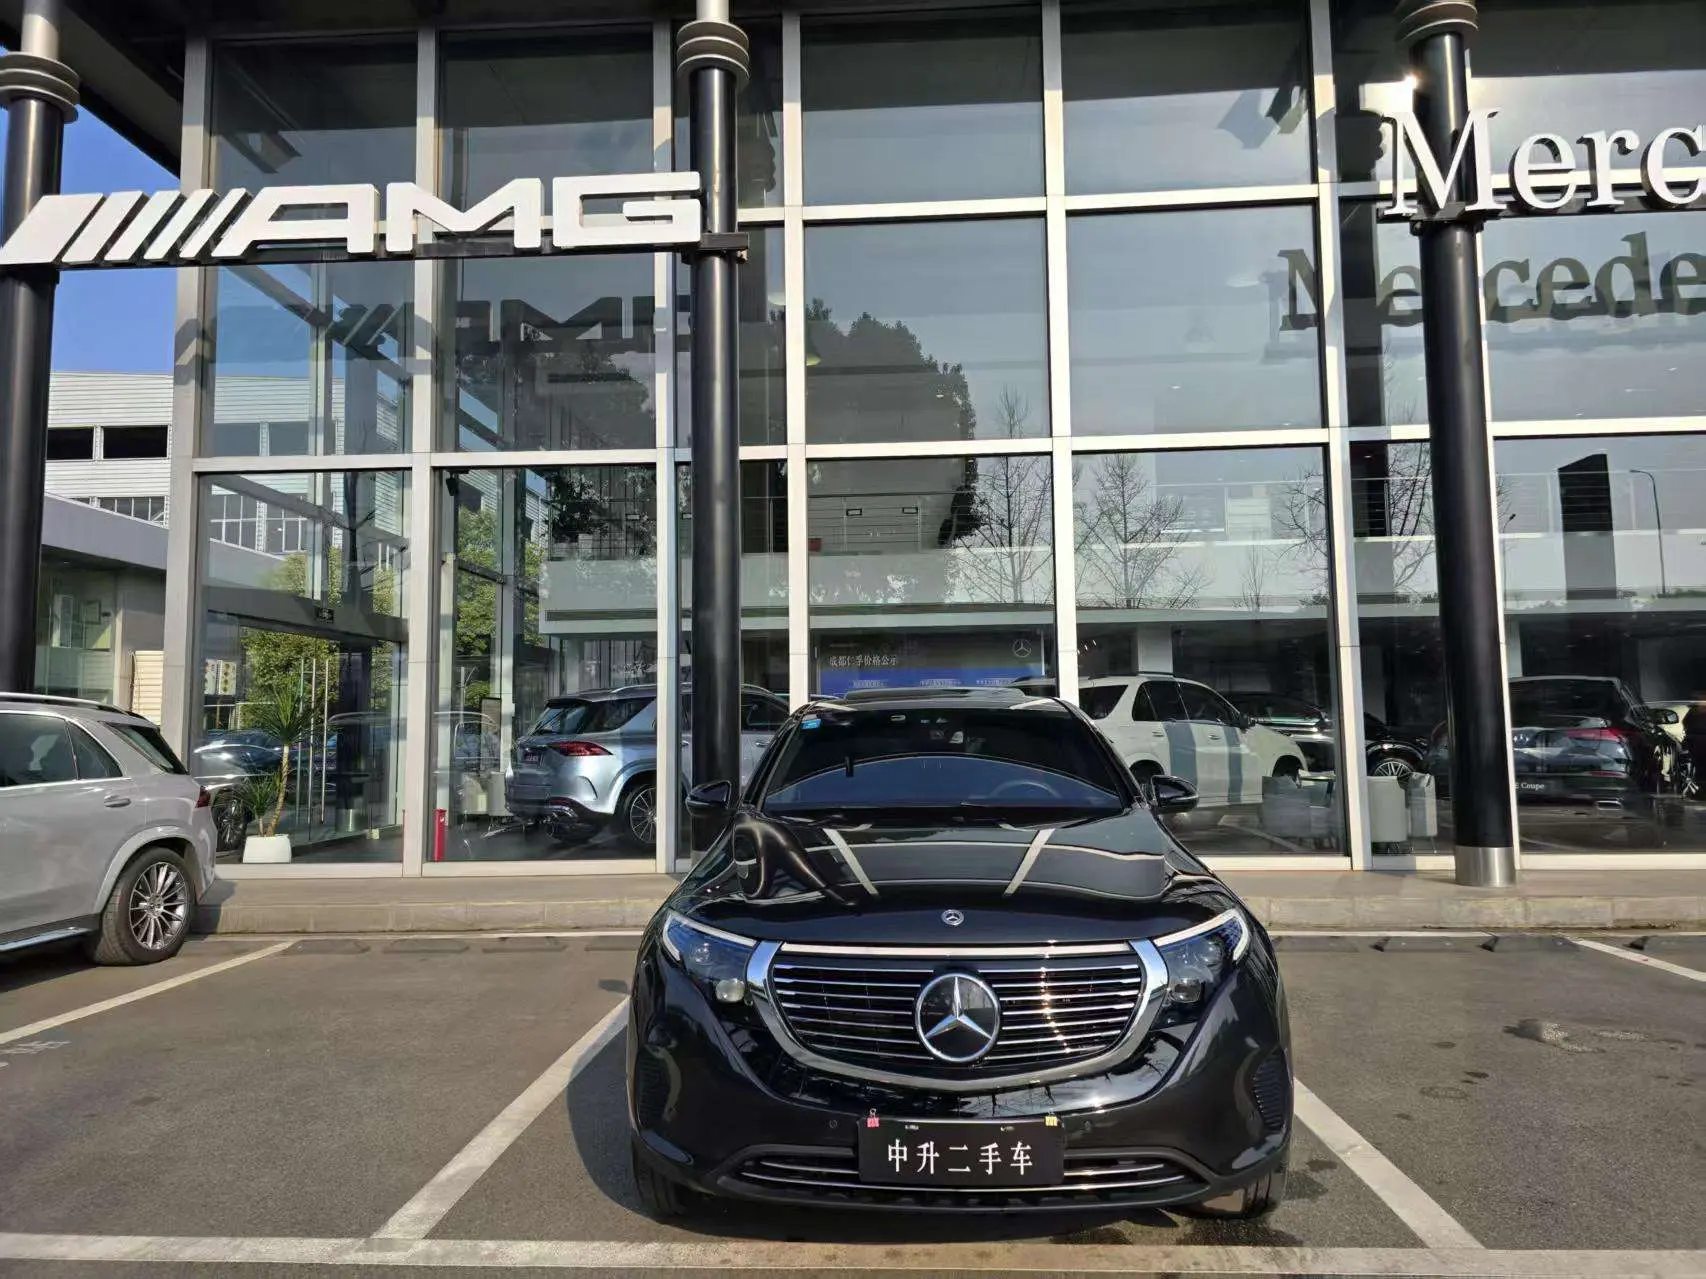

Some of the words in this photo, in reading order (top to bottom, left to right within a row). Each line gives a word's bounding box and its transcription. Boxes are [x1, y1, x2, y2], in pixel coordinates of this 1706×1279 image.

[211, 171, 702, 258] AMG
[1520, 782, 1545, 791] Coupe
[887, 1138, 1033, 1175] 中升二手车
